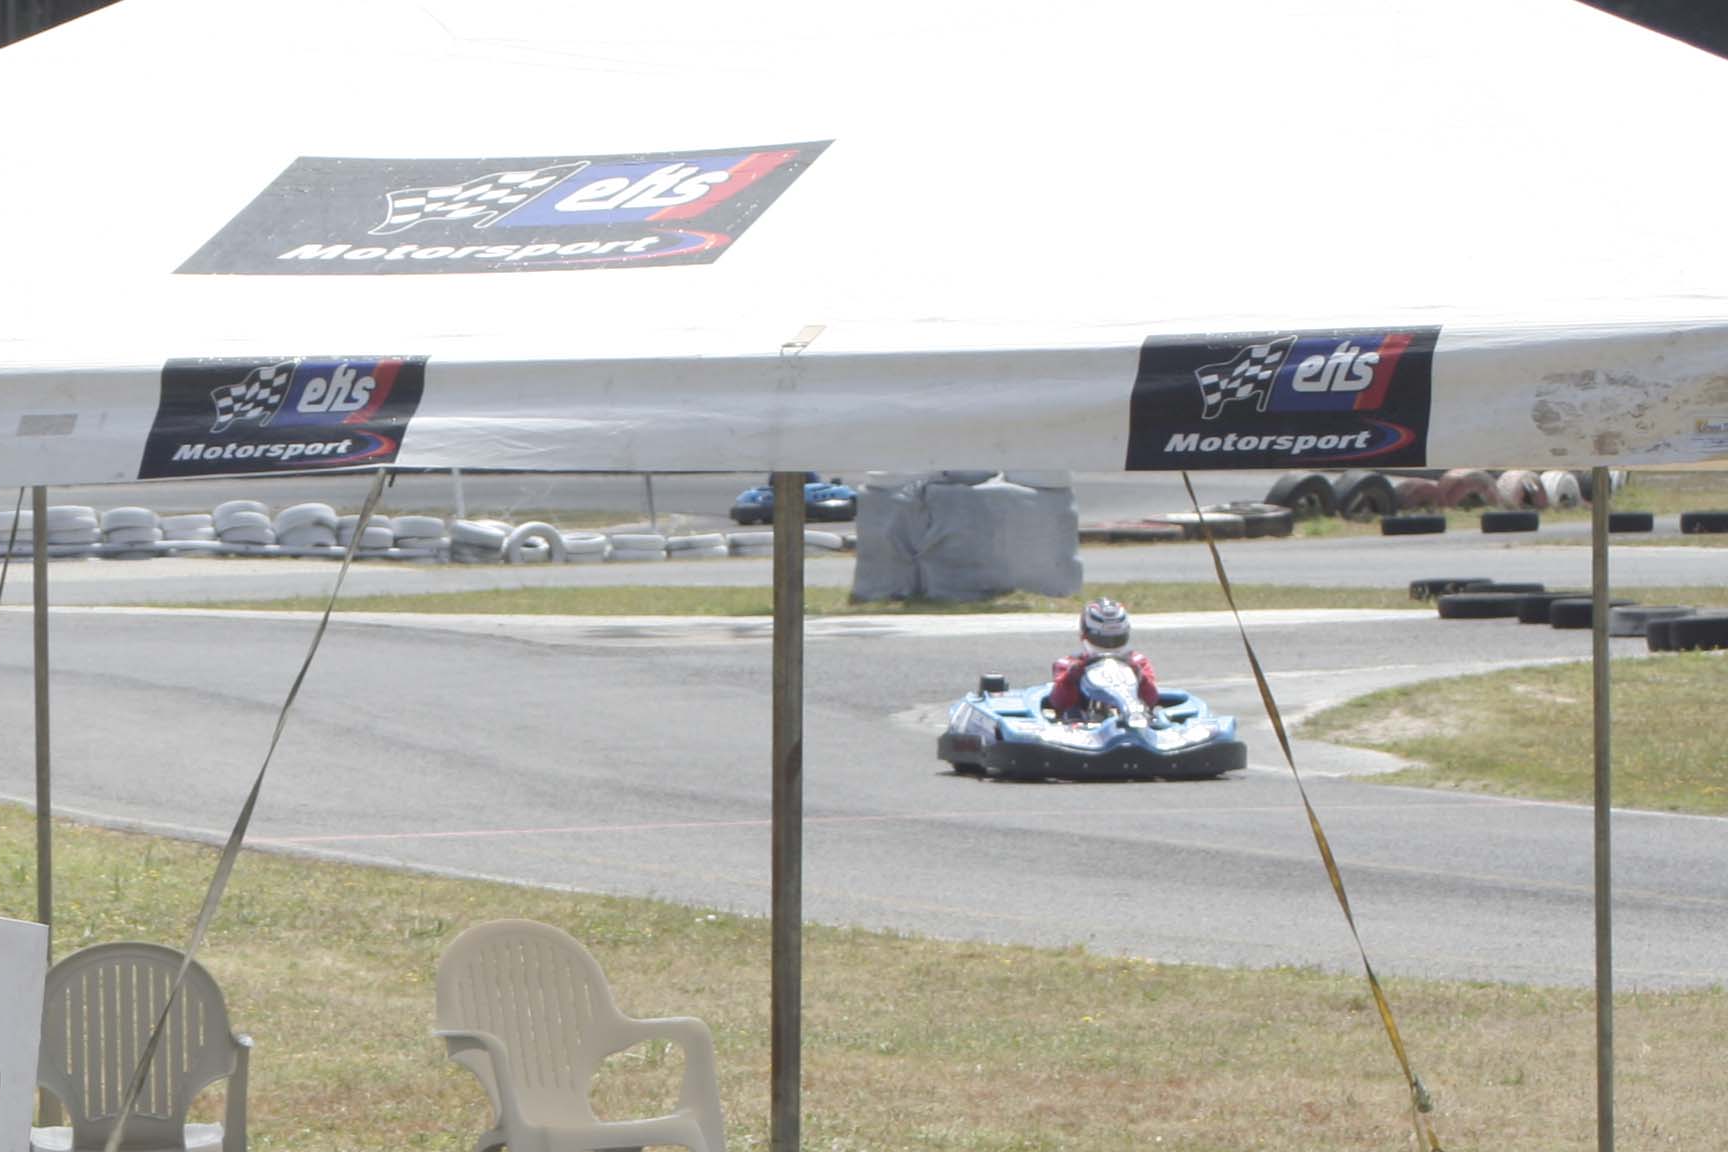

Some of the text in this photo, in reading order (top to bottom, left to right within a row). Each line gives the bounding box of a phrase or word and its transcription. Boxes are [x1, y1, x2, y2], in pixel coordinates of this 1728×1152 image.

[276, 232, 660, 262] Motorsport
[172, 438, 352, 461] Motorsport
[1165, 429, 1372, 455] Motorsport
